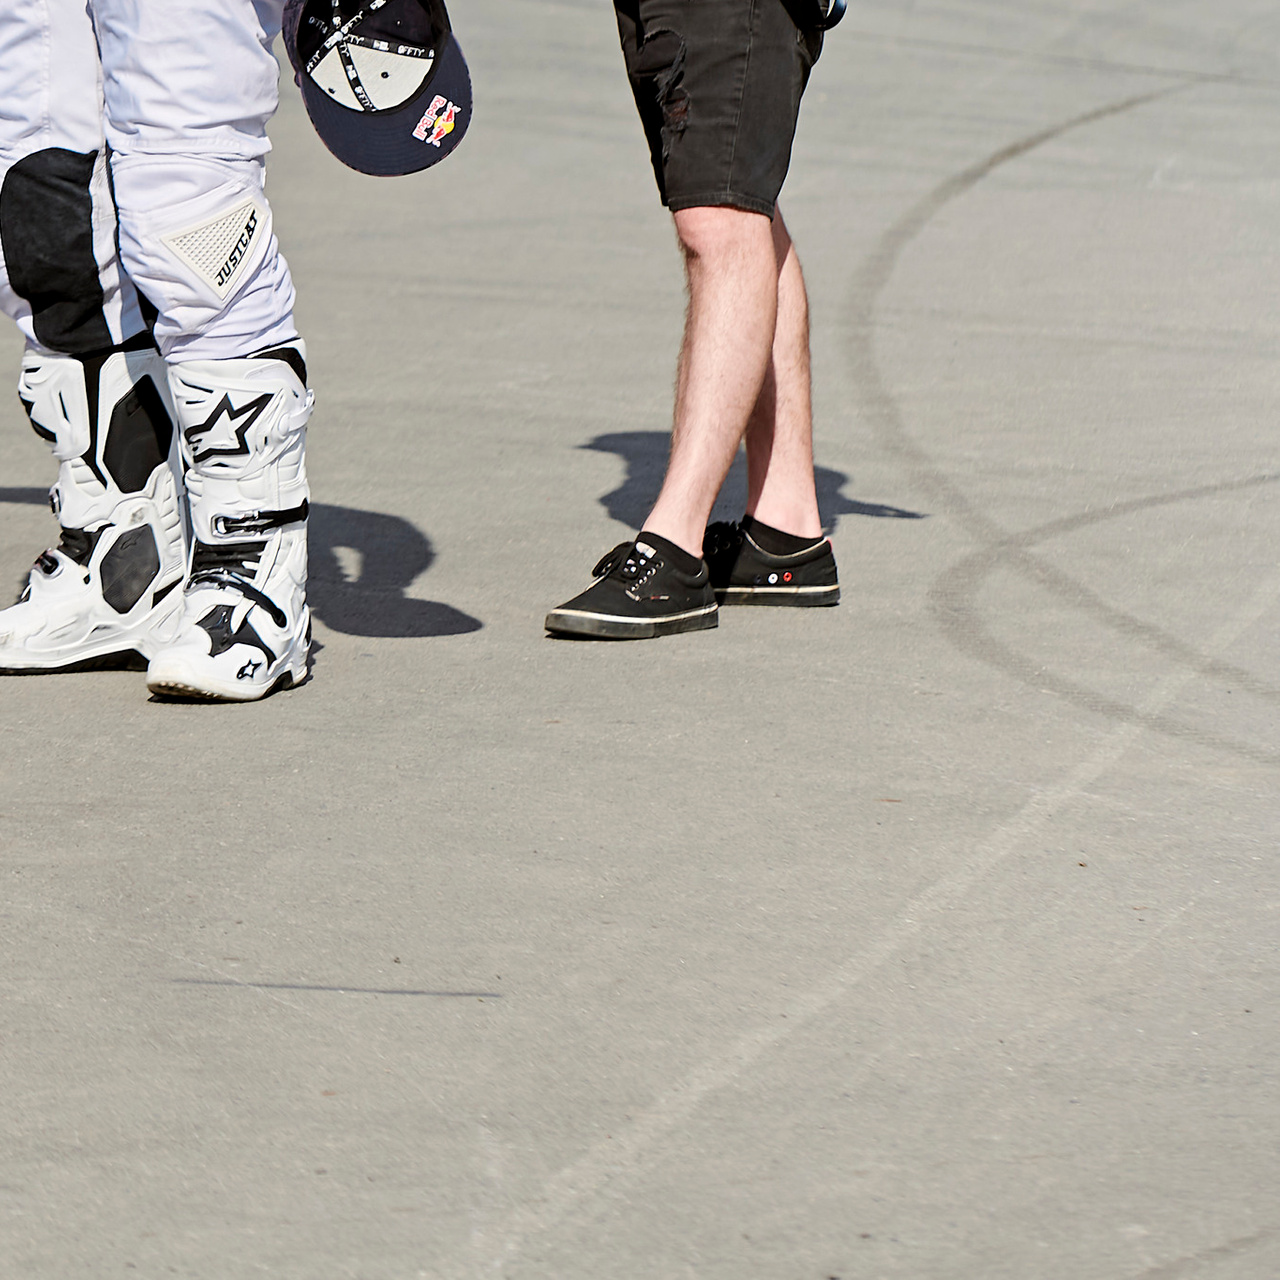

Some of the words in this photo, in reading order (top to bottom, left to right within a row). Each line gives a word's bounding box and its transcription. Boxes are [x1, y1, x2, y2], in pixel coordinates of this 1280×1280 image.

[426, 96, 445, 119] Red
[414, 116, 432, 139] Bull
[214, 209, 258, 287] JUSTCAT
